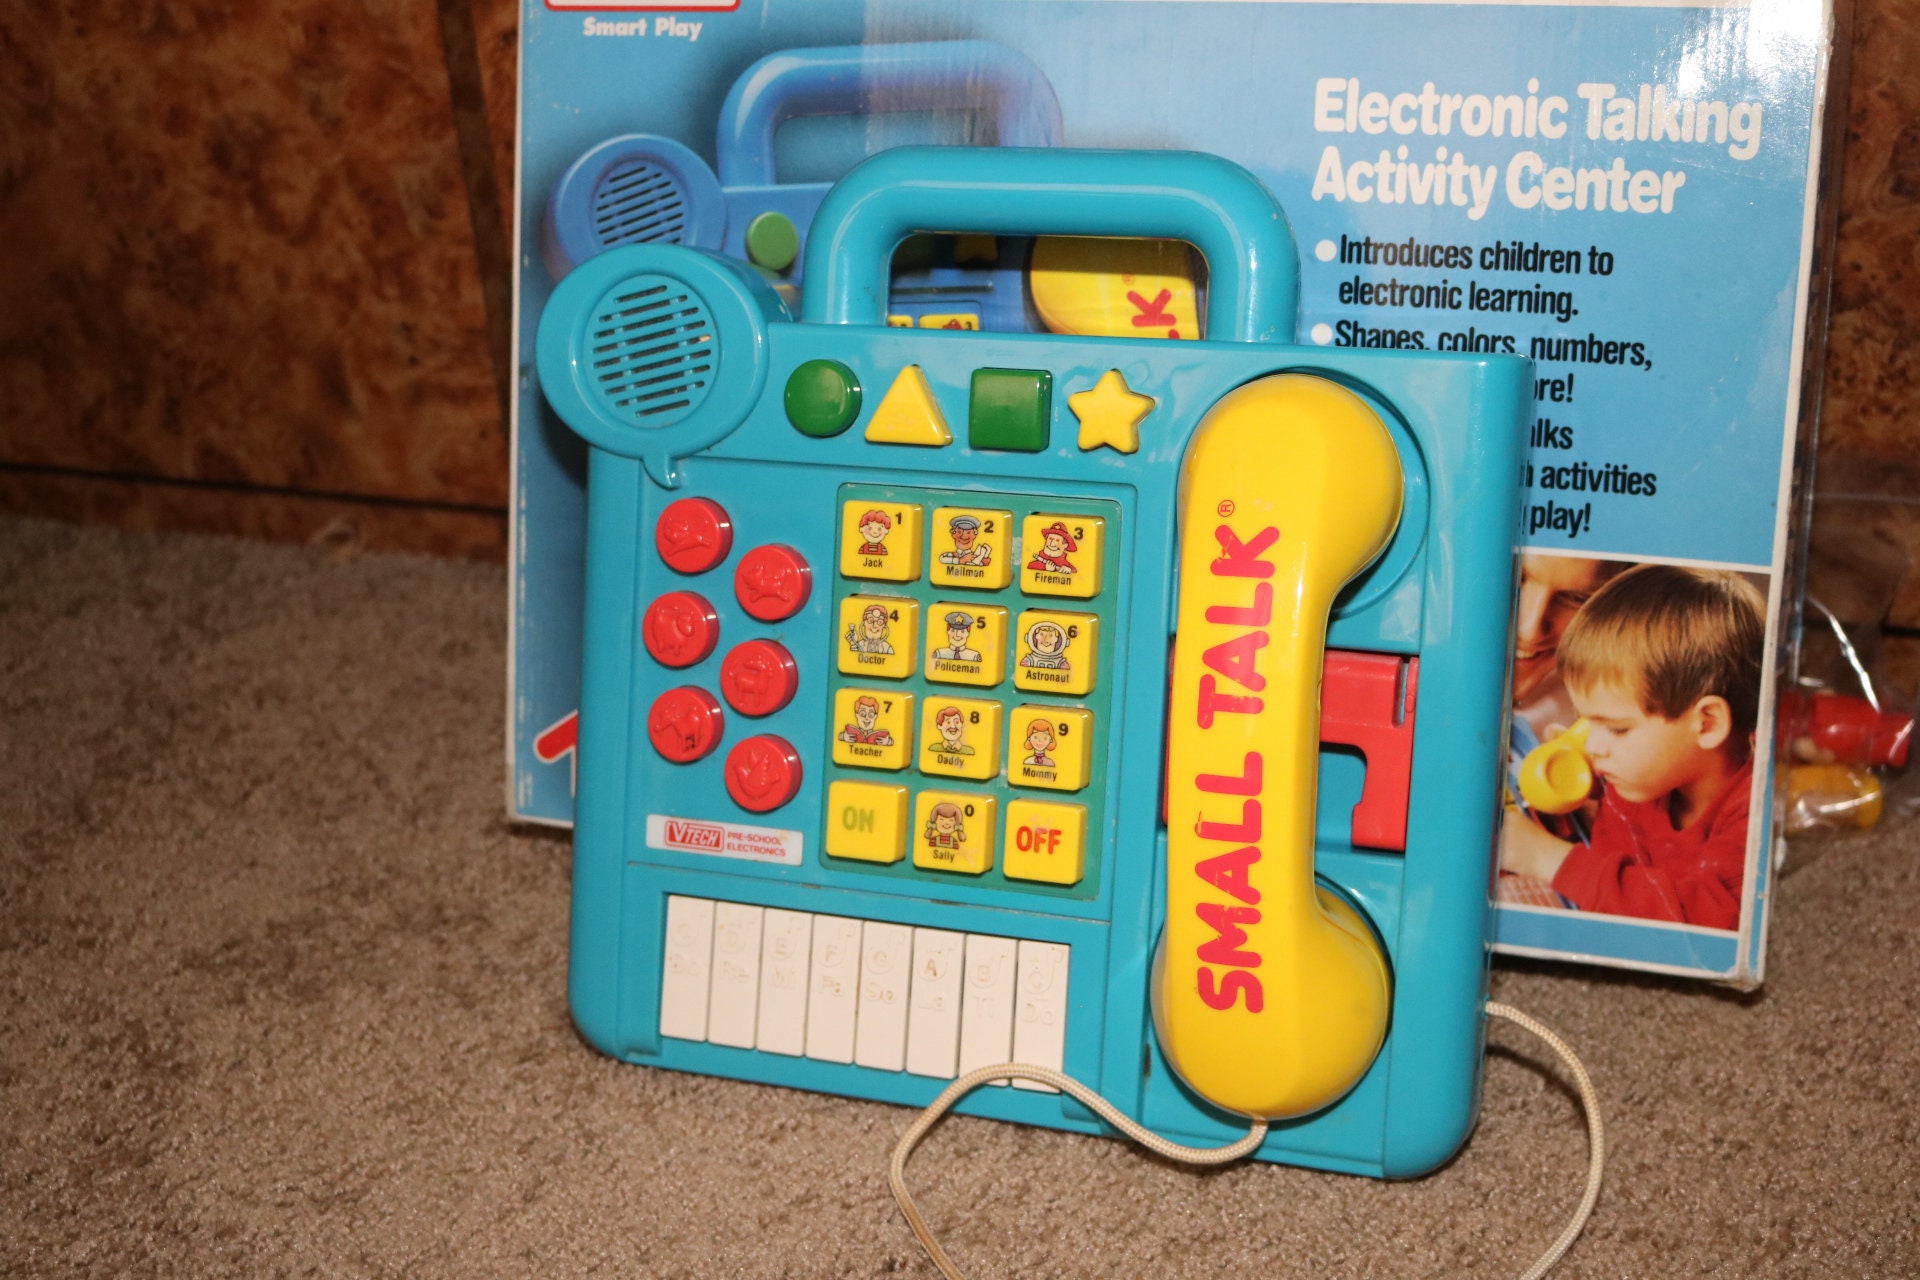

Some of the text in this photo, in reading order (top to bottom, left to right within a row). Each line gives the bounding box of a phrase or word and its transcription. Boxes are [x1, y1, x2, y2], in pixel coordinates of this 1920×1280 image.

[583, 17, 703, 42] Smart Play
[1313, 77, 1764, 161] Electronic Talking
[1311, 146, 1687, 221] Activity Center
[1340, 234, 1615, 276] Introduces children to
[1338, 275, 1580, 323] electronic learning.
[1335, 319, 1430, 350] Shapes
[1530, 332, 1653, 371] numbers,
[1540, 461, 1658, 497] activities
[896, 511, 903, 525] 1
[1529, 499, 1592, 539] play!
[983, 520, 994, 534] 2
[1073, 527, 1084, 541] 3
[863, 557, 883, 569] Jack
[946, 566, 984, 579] Mailman
[1034, 572, 1072, 586] Fireman
[889, 610, 899, 623] 4
[976, 616, 987, 630] 5
[1067, 625, 1078, 639] 6
[858, 653, 886, 666] Doctor
[934, 661, 980, 675] Policeman
[1026, 670, 1070, 684] Astronaut
[883, 701, 893, 714] 7
[970, 711, 980, 725] 8
[1058, 723, 1069, 737] 9
[849, 744, 883, 758] Teacher
[937, 754, 965, 768] Daddy
[1022, 767, 1058, 782] Mommy
[964, 804, 975, 818] 0
[842, 806, 874, 834] ON
[666, 821, 720, 848] VTECH
[727, 831, 783, 846] PRE-SCHOOL
[1016, 825, 1063, 855] OFF
[727, 842, 787, 858] ELECTRONICS
[933, 849, 955, 863] Sally
[1194, 750, 1264, 1014] SMALL
[924, 958, 938, 977] A
